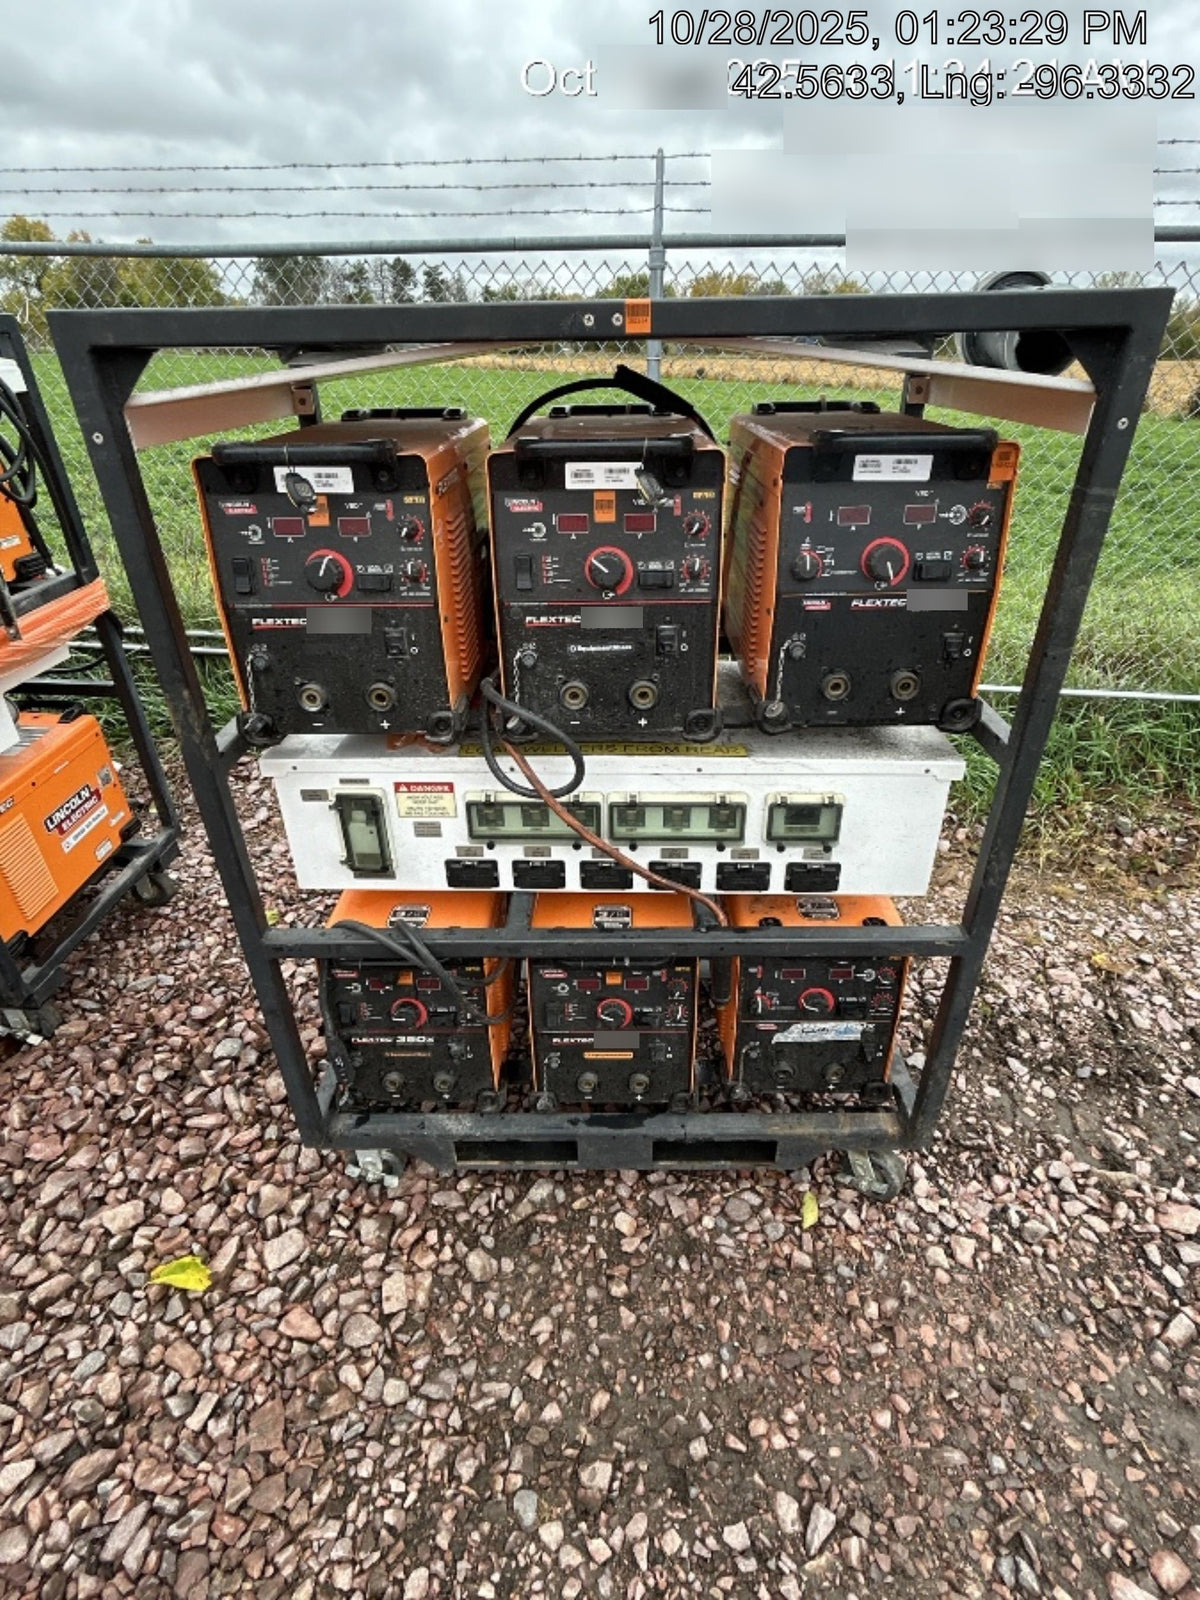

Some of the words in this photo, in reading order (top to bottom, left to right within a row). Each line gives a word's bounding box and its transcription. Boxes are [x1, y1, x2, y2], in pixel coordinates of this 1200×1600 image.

[850, 598, 907, 607] FLEXTEC
[251, 618, 308, 626] FLEXTEC
[525, 615, 582, 624] FLEXTEC
[623, 743, 681, 754] FROM
[46, 786, 92, 830] LINCOLN
[61, 795, 98, 831] ELECTRIC
